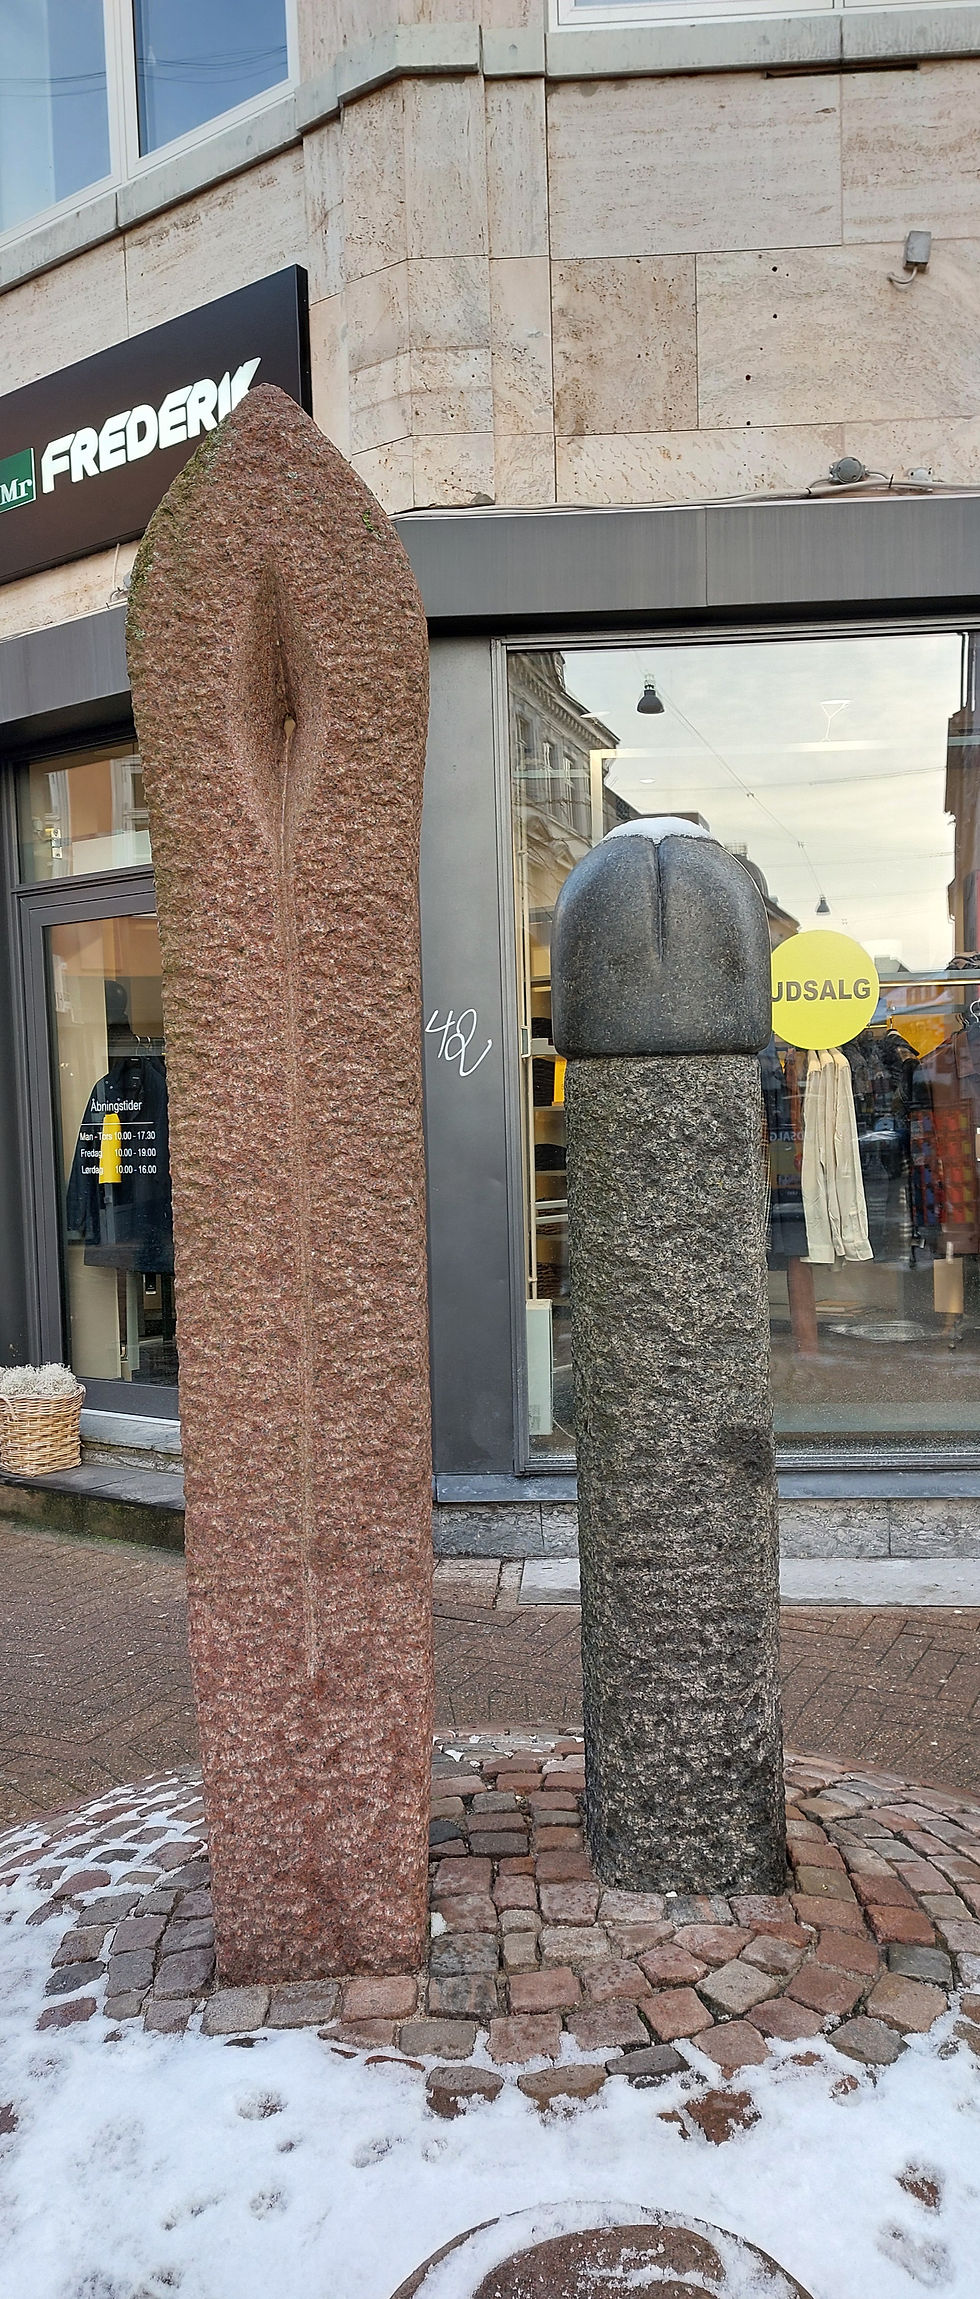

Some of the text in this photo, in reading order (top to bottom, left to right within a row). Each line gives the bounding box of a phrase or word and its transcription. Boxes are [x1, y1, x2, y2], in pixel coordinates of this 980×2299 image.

[0, 356, 262, 505] Mr FREDERIK
[771, 978, 871, 1002] UDSALG
[90, 1098, 143, 1113] Åbningstider
[79, 1132, 94, 1141] Man
[98, 1132, 113, 1141] Tors
[114, 1131, 132, 1140] 10.00
[137, 1131, 156, 1140] 17.30
[80, 1149, 103, 1159] Fredag
[114, 1148, 133, 1157] 10.00
[138, 1148, 157, 1157] 19.00
[81, 1165, 104, 1175] Lørdag
[115, 1165, 134, 1174] 10.00
[138, 1165, 157, 1174] 16.00
